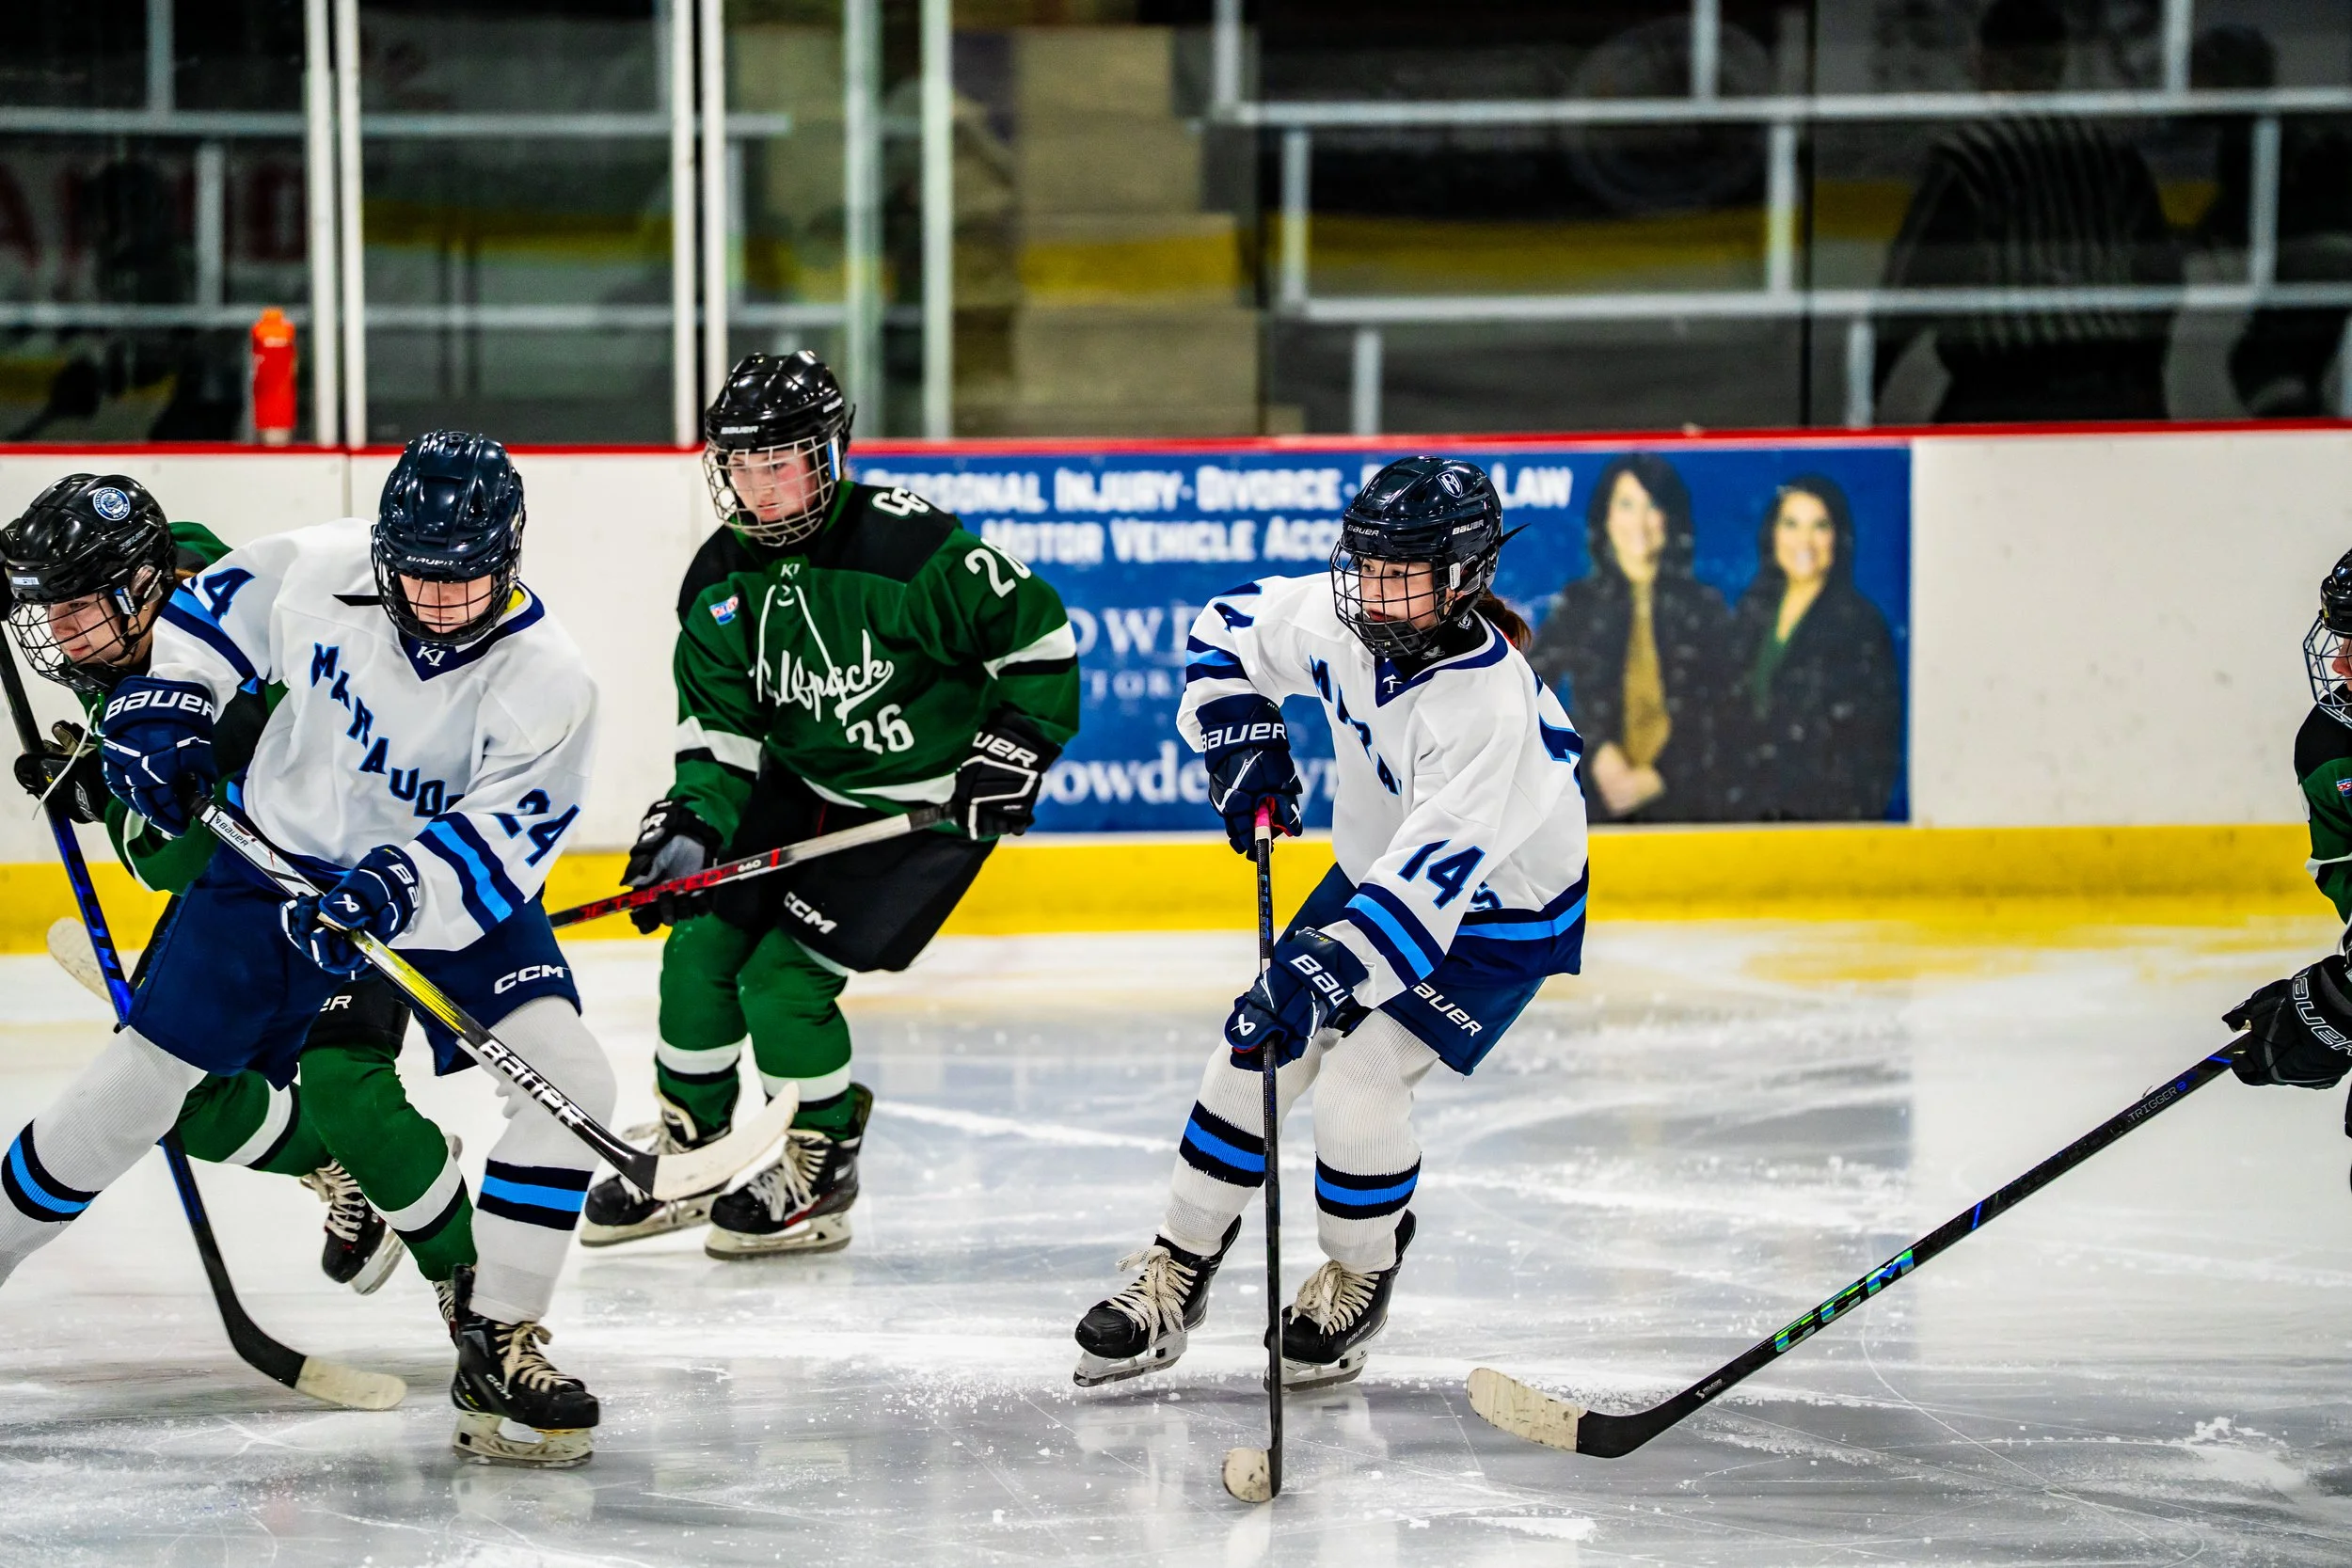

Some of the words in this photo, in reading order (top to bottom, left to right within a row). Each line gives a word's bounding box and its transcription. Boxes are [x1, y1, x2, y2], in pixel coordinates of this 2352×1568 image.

[1347, 524, 1379, 537] BAUER
[1452, 519, 1485, 535] BAUER
[104, 689, 215, 722] BAUER
[846, 704, 914, 754] 26
[1201, 722, 1287, 753] BAUER
[972, 731, 1039, 768] UER
[219, 822, 250, 847] BAUER
[493, 788, 580, 867] 24
[1397, 838, 1486, 910] 14
[784, 891, 837, 934] CCM
[494, 965, 568, 994] CCM
[1410, 982, 1483, 1037] AUER
[2128, 1086, 2178, 1121] TRIGGER
[1774, 1247, 1915, 1353] CCM
